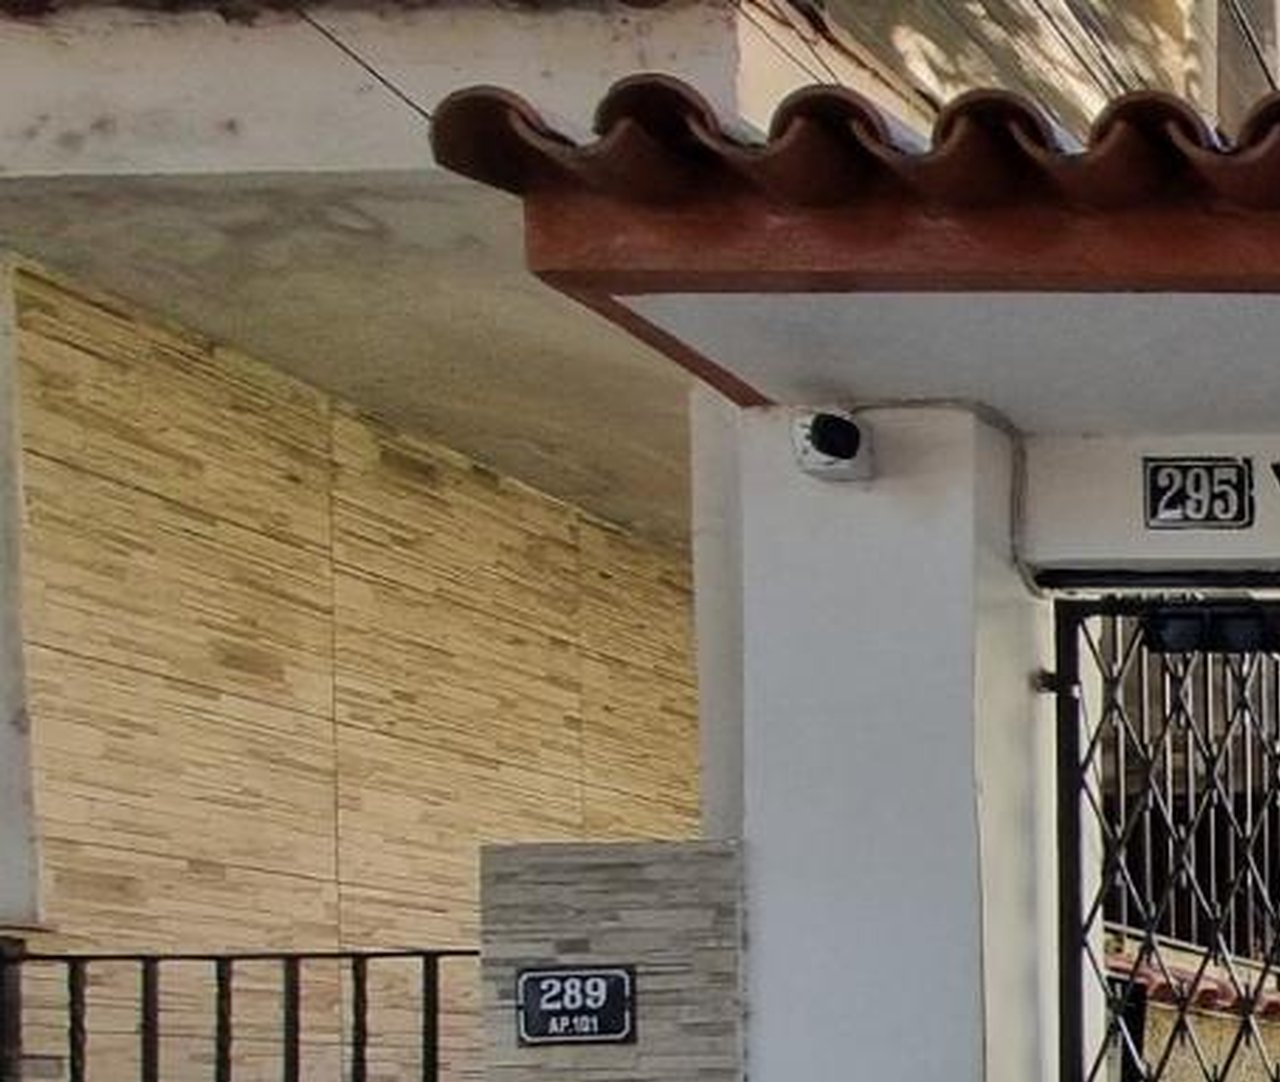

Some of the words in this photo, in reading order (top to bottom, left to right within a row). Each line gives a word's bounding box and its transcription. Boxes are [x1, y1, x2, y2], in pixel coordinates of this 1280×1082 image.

[1156, 466, 1239, 520] 295
[539, 977, 608, 1011] 289
[548, 1014, 599, 1035] AP.101
